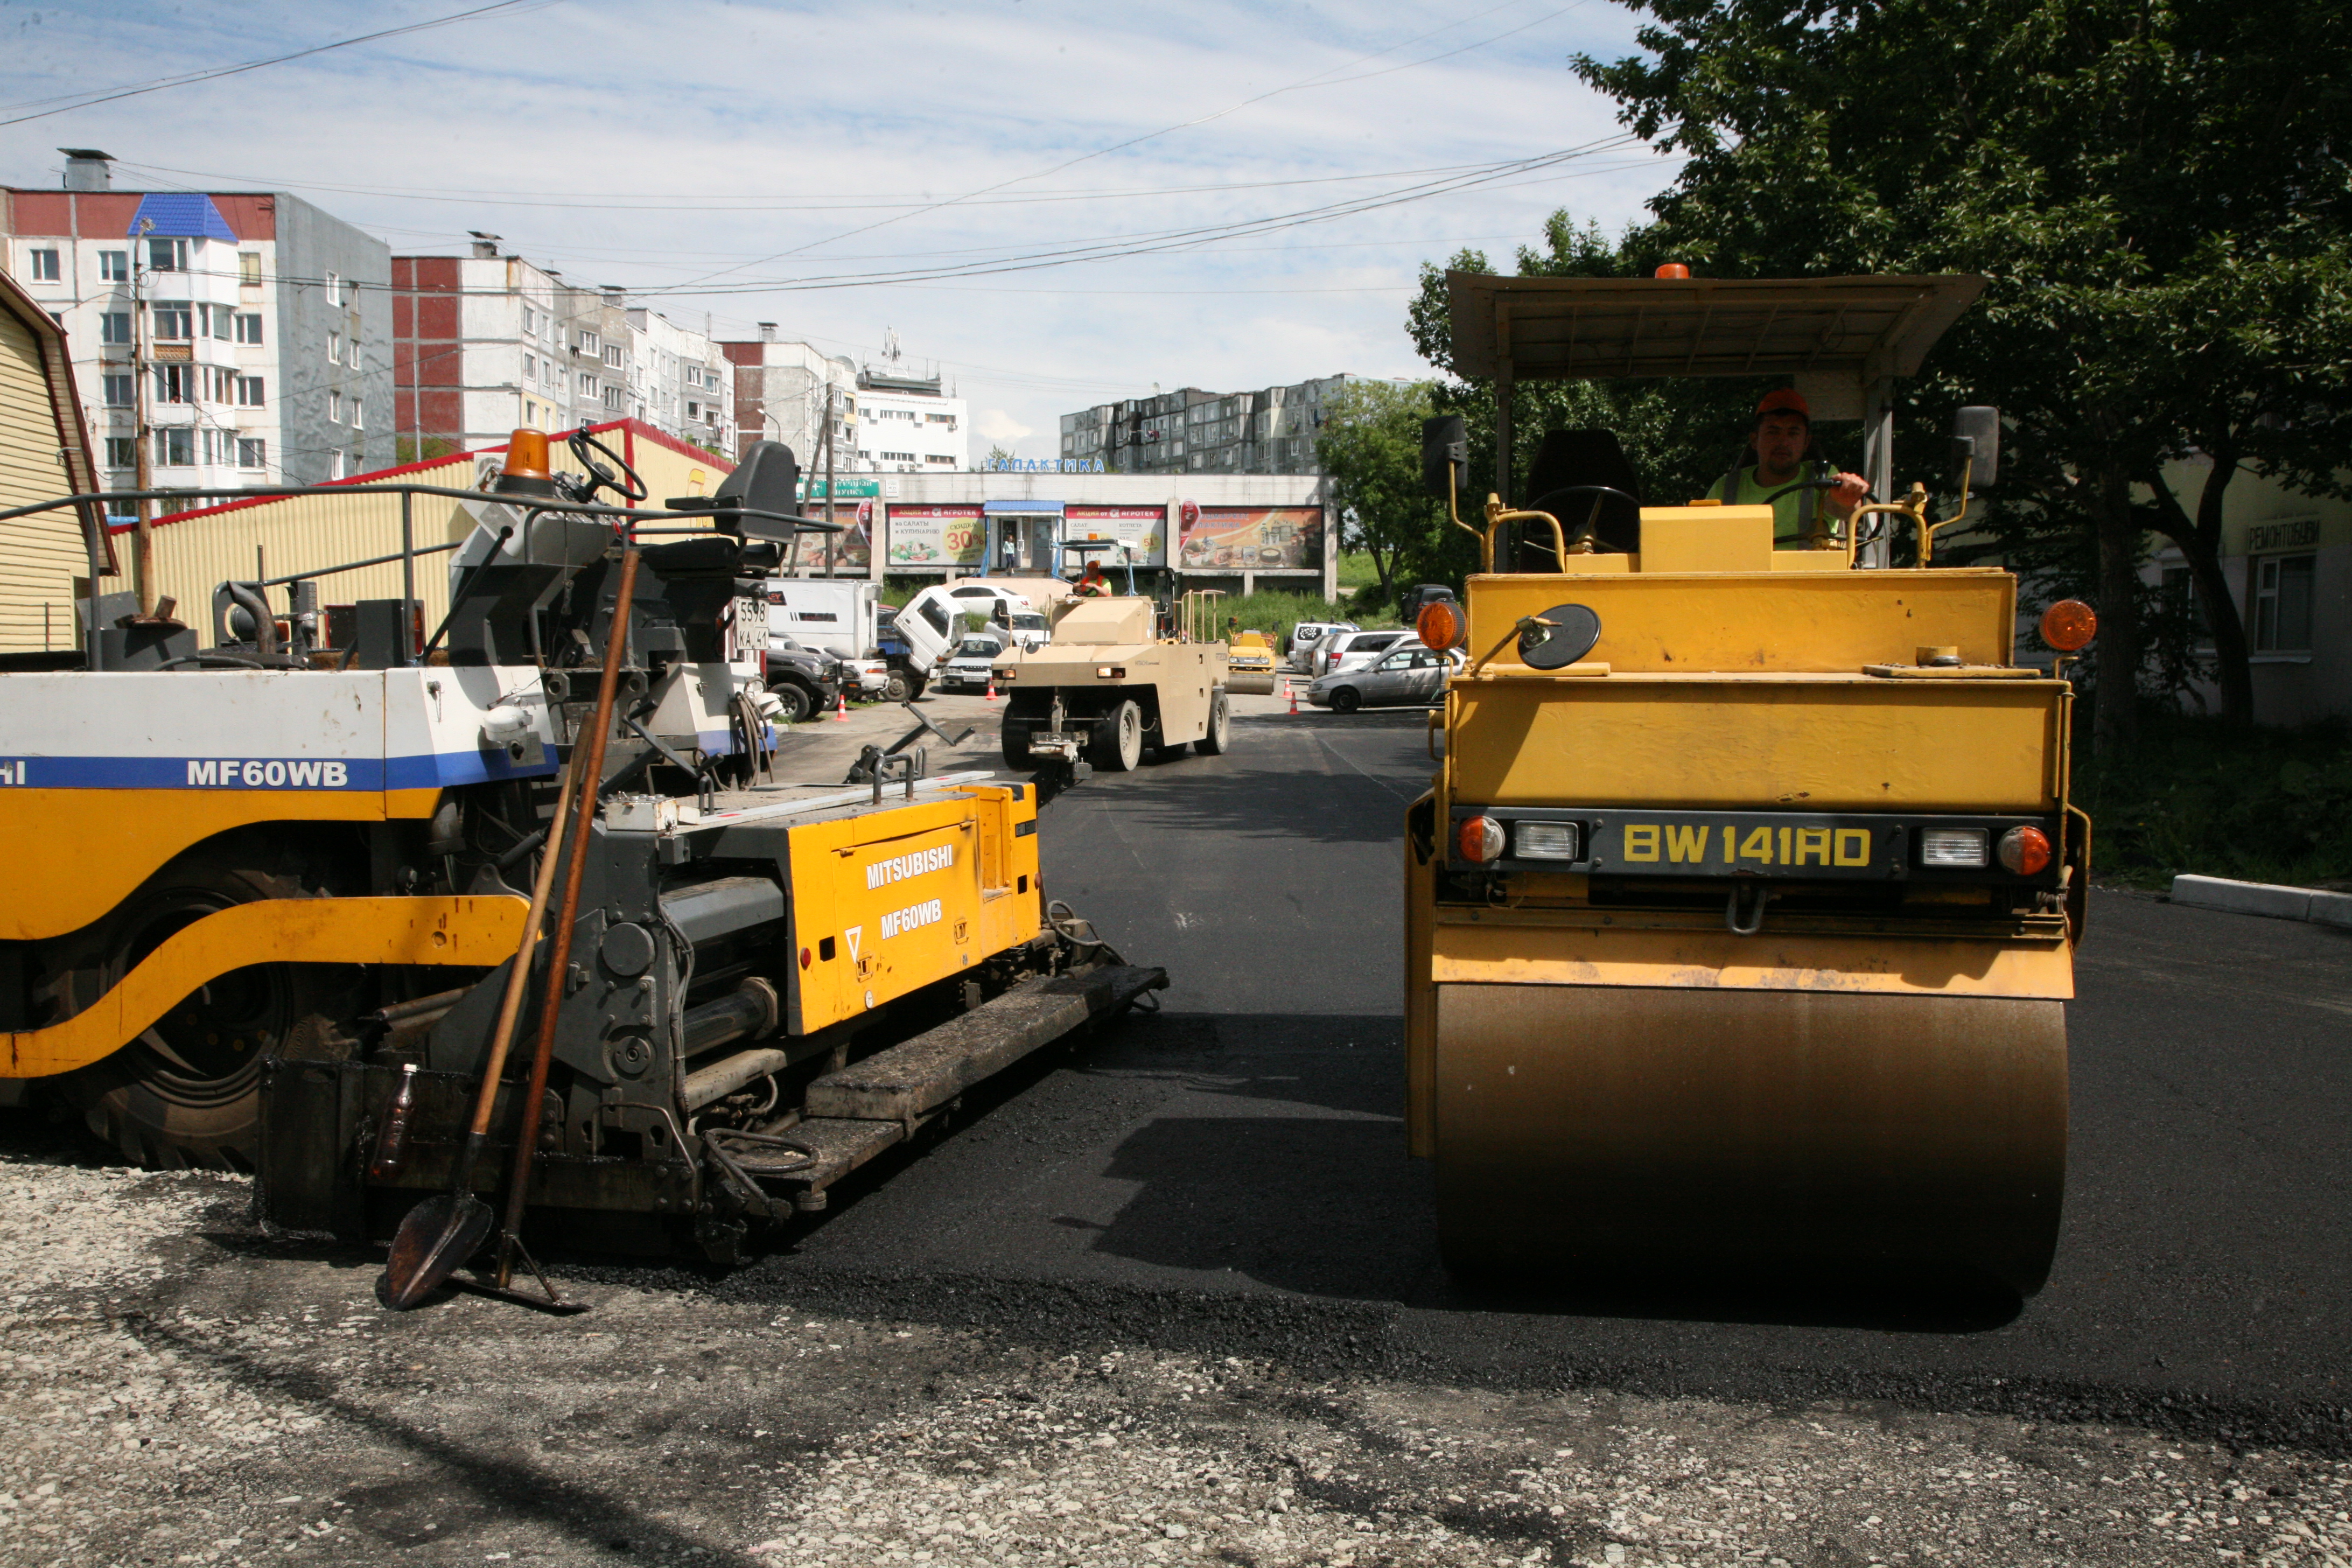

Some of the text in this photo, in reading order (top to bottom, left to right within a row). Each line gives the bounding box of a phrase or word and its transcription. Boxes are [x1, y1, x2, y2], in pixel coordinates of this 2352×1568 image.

[987, 458, 1104, 472] ГАЛАКТИКА
[947, 530, 984, 550] 30%
[741, 602, 765, 622] 5598
[739, 631, 766, 647] КА 41
[187, 761, 348, 787] MF60WB
[1624, 825, 1871, 866] BW 141AD
[866, 843, 953, 890] MITSUBISHI
[881, 898, 942, 940] MF60WB
